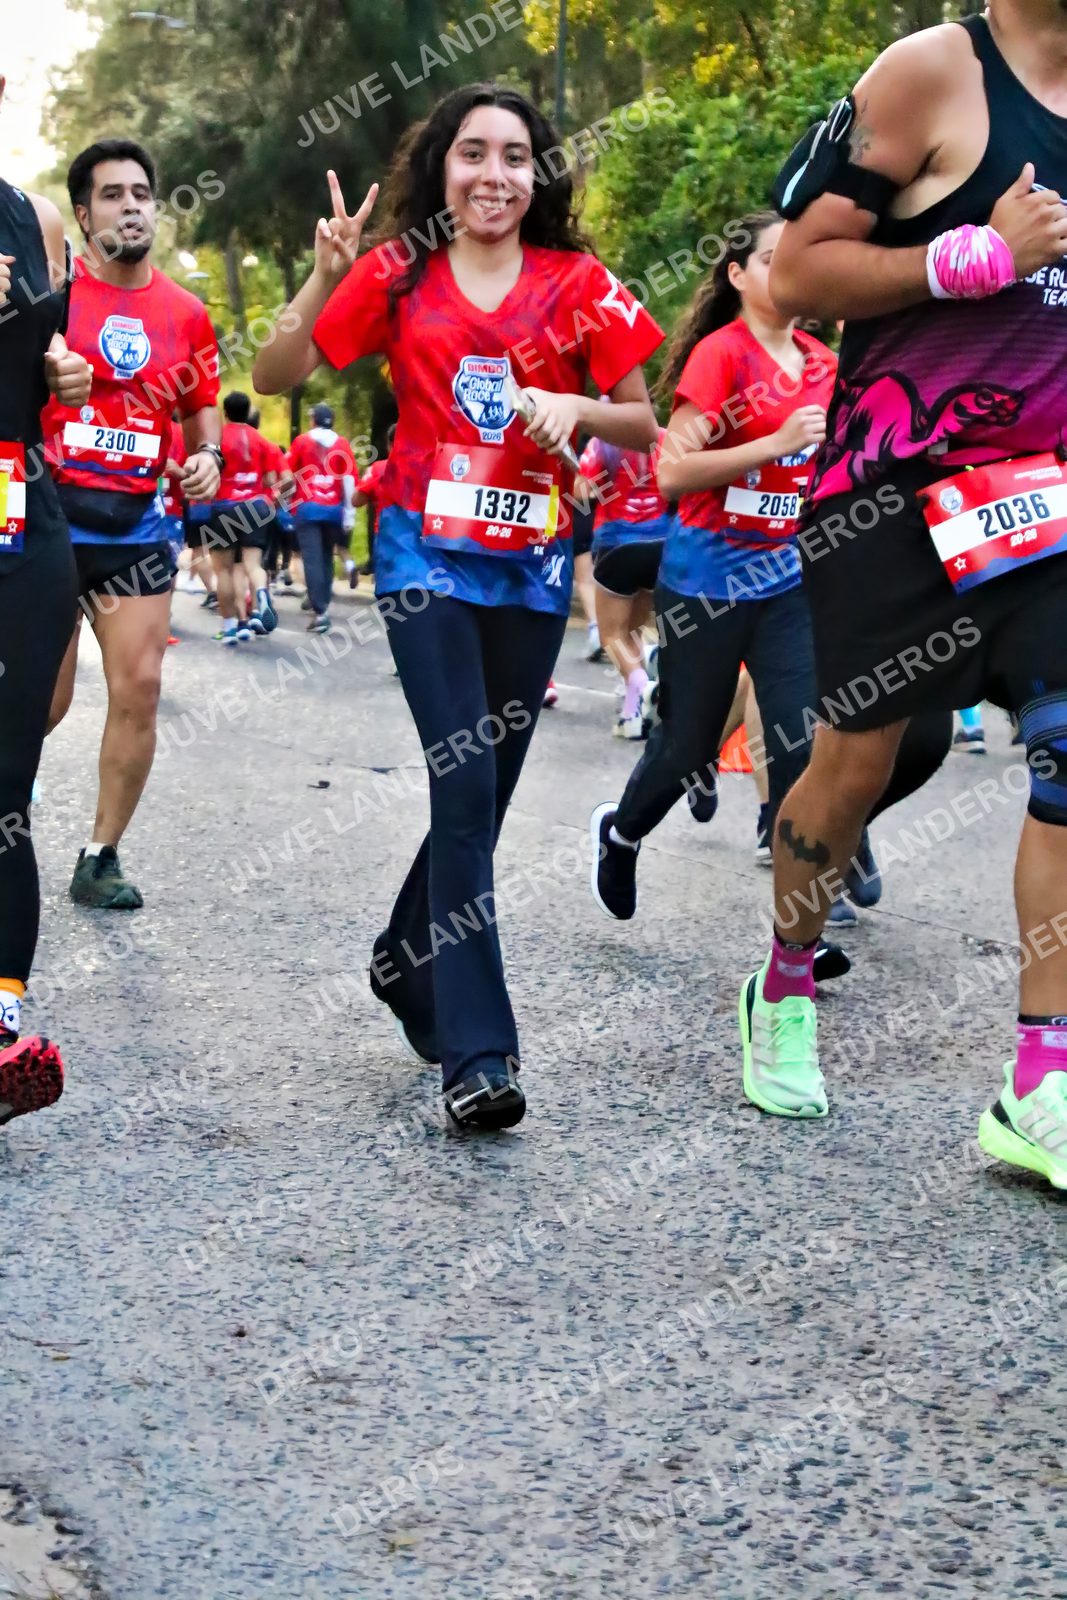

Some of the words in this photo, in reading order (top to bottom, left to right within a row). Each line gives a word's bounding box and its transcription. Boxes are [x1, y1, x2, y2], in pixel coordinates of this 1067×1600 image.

[467, 363, 503, 374] BIMBO
[469, 376, 503, 393] Global
[463, 388, 491, 402] Race
[94, 428, 136, 453] 2300
[474, 487, 531, 524] 1332
[757, 493, 798, 517] 2058
[976, 492, 1051, 538] 2036
[532, 545, 545, 556] 5K
